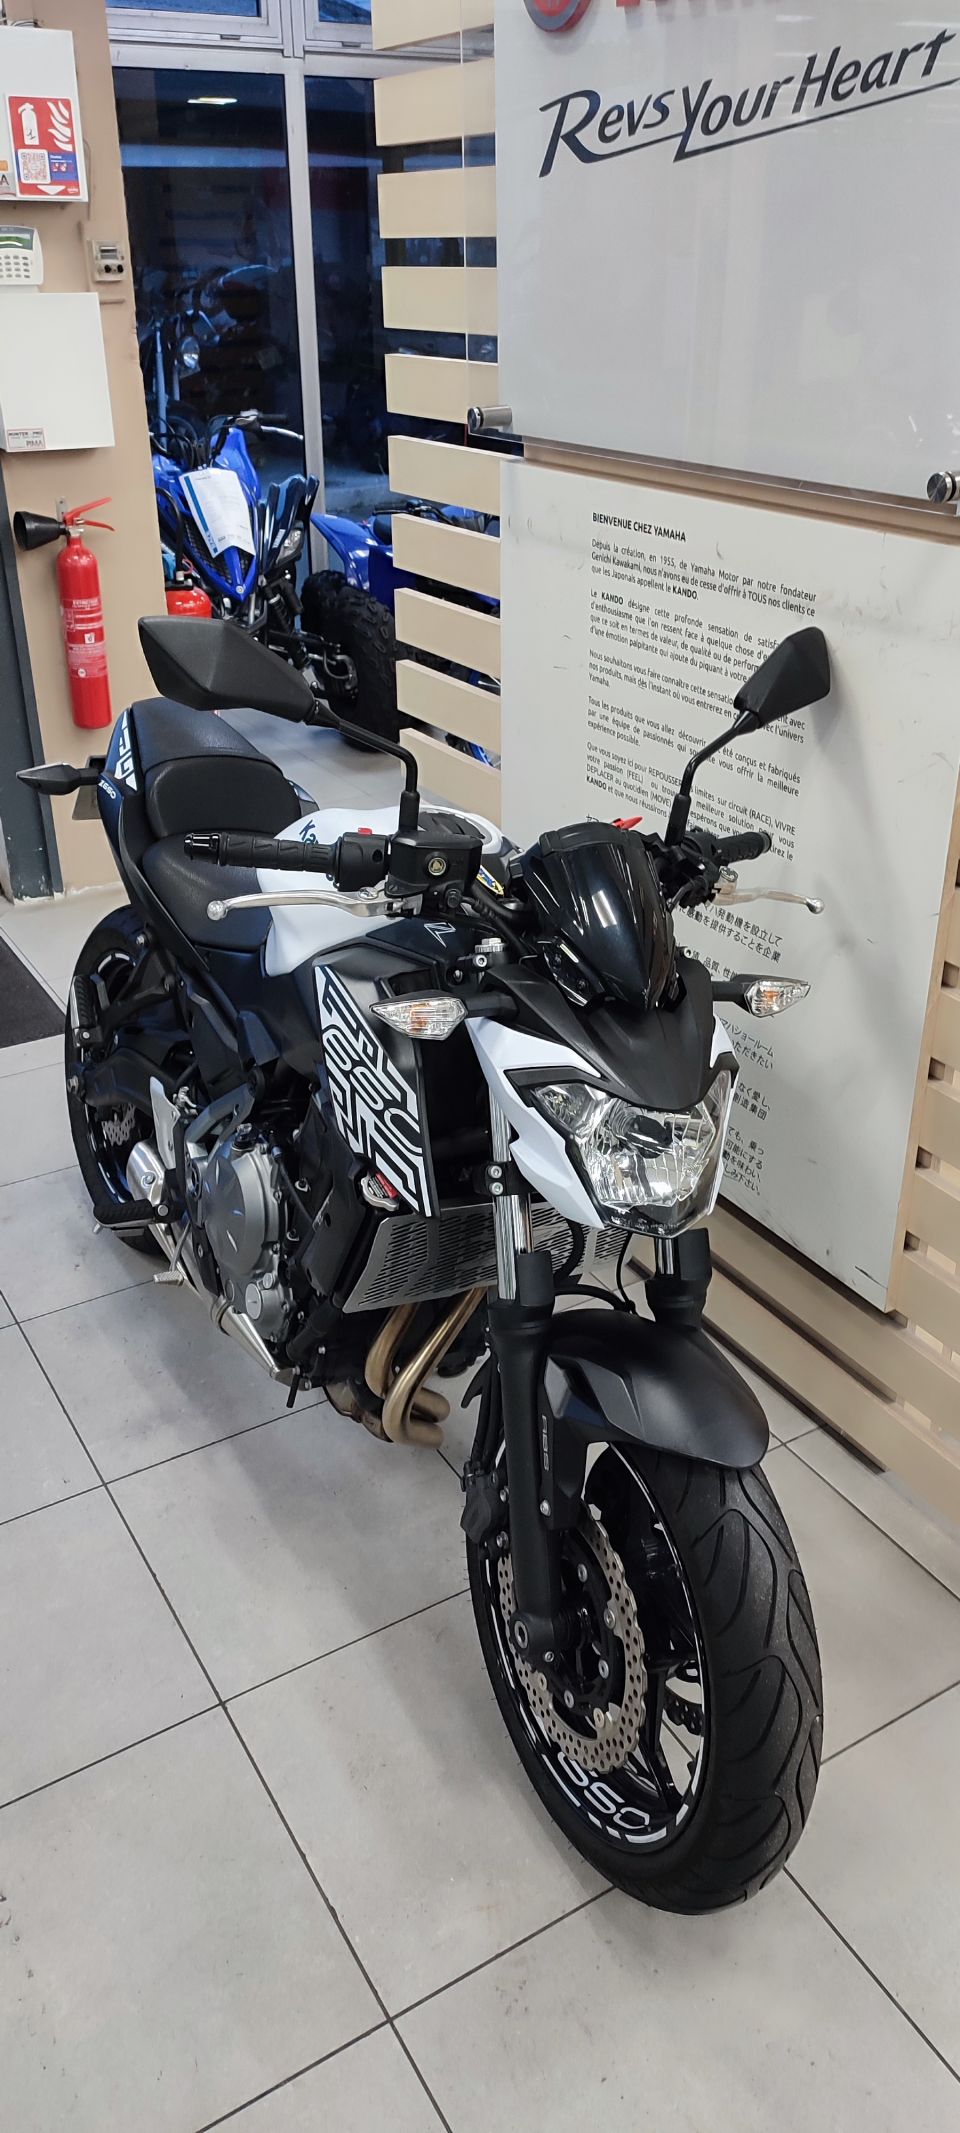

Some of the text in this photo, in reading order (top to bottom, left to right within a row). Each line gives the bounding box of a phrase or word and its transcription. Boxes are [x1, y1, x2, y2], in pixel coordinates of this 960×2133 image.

[538, 28, 957, 178] Revs Your Heart
[593, 513, 686, 542] BIENVENUE CHEZ YAMAHA
[592, 539, 816, 601] Depuis création, 1955, de Yamaha Motor par notre fondateur
[592, 566, 601, 574] que
[612, 570, 635, 583] Japonais
[637, 578, 664, 591] appellent
[672, 585, 698, 600] KANDO.
[592, 552, 815, 617] Genichi Kawakami, nous n'avons de cesse d'offrir TOUS nos clients ce
[590, 615, 600, 623] que
[609, 620, 619, 629] soit
[630, 625, 649, 638] termes
[660, 636, 678, 649] valeur,
[681, 640, 688, 651] de
[690, 645, 711, 658] qualité
[723, 653, 731, 664] de
[591, 601, 632, 620] d'enthousiasme
[635, 616, 645, 625] que
[648, 617, 658, 628] l'on
[661, 624, 682, 636] ressent
[685, 628, 698, 640] face
[707, 637, 732, 651] quelque
[735, 644, 754, 657] chose
[601, 592, 623, 605] KANDO
[628, 599, 650, 613] désigne
[655, 609, 669, 619] cette
[674, 614, 702, 628] profonde
[708, 624, 738, 638] sensation
[744, 632, 752, 643] de
[590, 625, 747, 683] d'une émotion palpitante qui ajoute du piquant votre
[589, 662, 598, 671] nos
[599, 666, 622, 680] produits,
[624, 674, 636, 684] mais
[638, 677, 647, 689] dès
[648, 681, 671, 696] l'instant
[681, 695, 695, 705] vous
[696, 700, 722, 715] entrerez
[775, 725, 803, 743] l'univers
[590, 649, 603, 660] Nous
[604, 656, 632, 671] souhaitons
[634, 665, 646, 675] vous
[647, 668, 660, 680] faire
[662, 675, 689, 690] connaître
[690, 685, 706, 696] cette
[789, 718, 805, 730] avec
[588, 721, 640, 746] expérience possible.
[589, 696, 600, 707] Tous
[610, 706, 633, 719] produits
[635, 715, 645, 724] que
[647, 719, 659, 730] vous
[661, 724, 674, 735] allez
[677, 728, 707, 748] découvrir
[722, 744, 733, 758] été
[735, 753, 757, 767] conçus
[768, 763, 800, 783] fabriqués
[599, 714, 609, 722] une
[612, 717, 630, 730] équipe
[643, 731, 674, 747] passionnés
[677, 744, 686, 752] qui
[719, 760, 733, 771] vous
[737, 766, 754, 778] offrir
[767, 779, 799, 796] meilleure
[586, 775, 667, 817] KANDO que nous réussirons
[587, 742, 598, 752] Que
[599, 748, 611, 758] vous
[612, 753, 626, 764] soyez
[634, 763, 647, 772] pour
[695, 786, 714, 801] limites
[718, 798, 727, 806] sur
[728, 802, 747, 815] circuit
[749, 809, 773, 827] (RACE),
[775, 819, 795, 835] VIVRE
[587, 764, 613, 782] DEPLACER
[623, 781, 648, 797] quotidien
[690, 811, 717, 827] espérons
[719, 823, 730, 833] que
[587, 755, 600, 765] votre
[604, 761, 623, 774] passion
[627, 770, 643, 784] (FEEL)
[696, 801, 724, 818] meilleure
[729, 815, 754, 830] solution
[779, 836, 794, 848] vous
[725, 1138, 763, 1170] 可能にする
[541, 1415, 550, 1472] ABS
